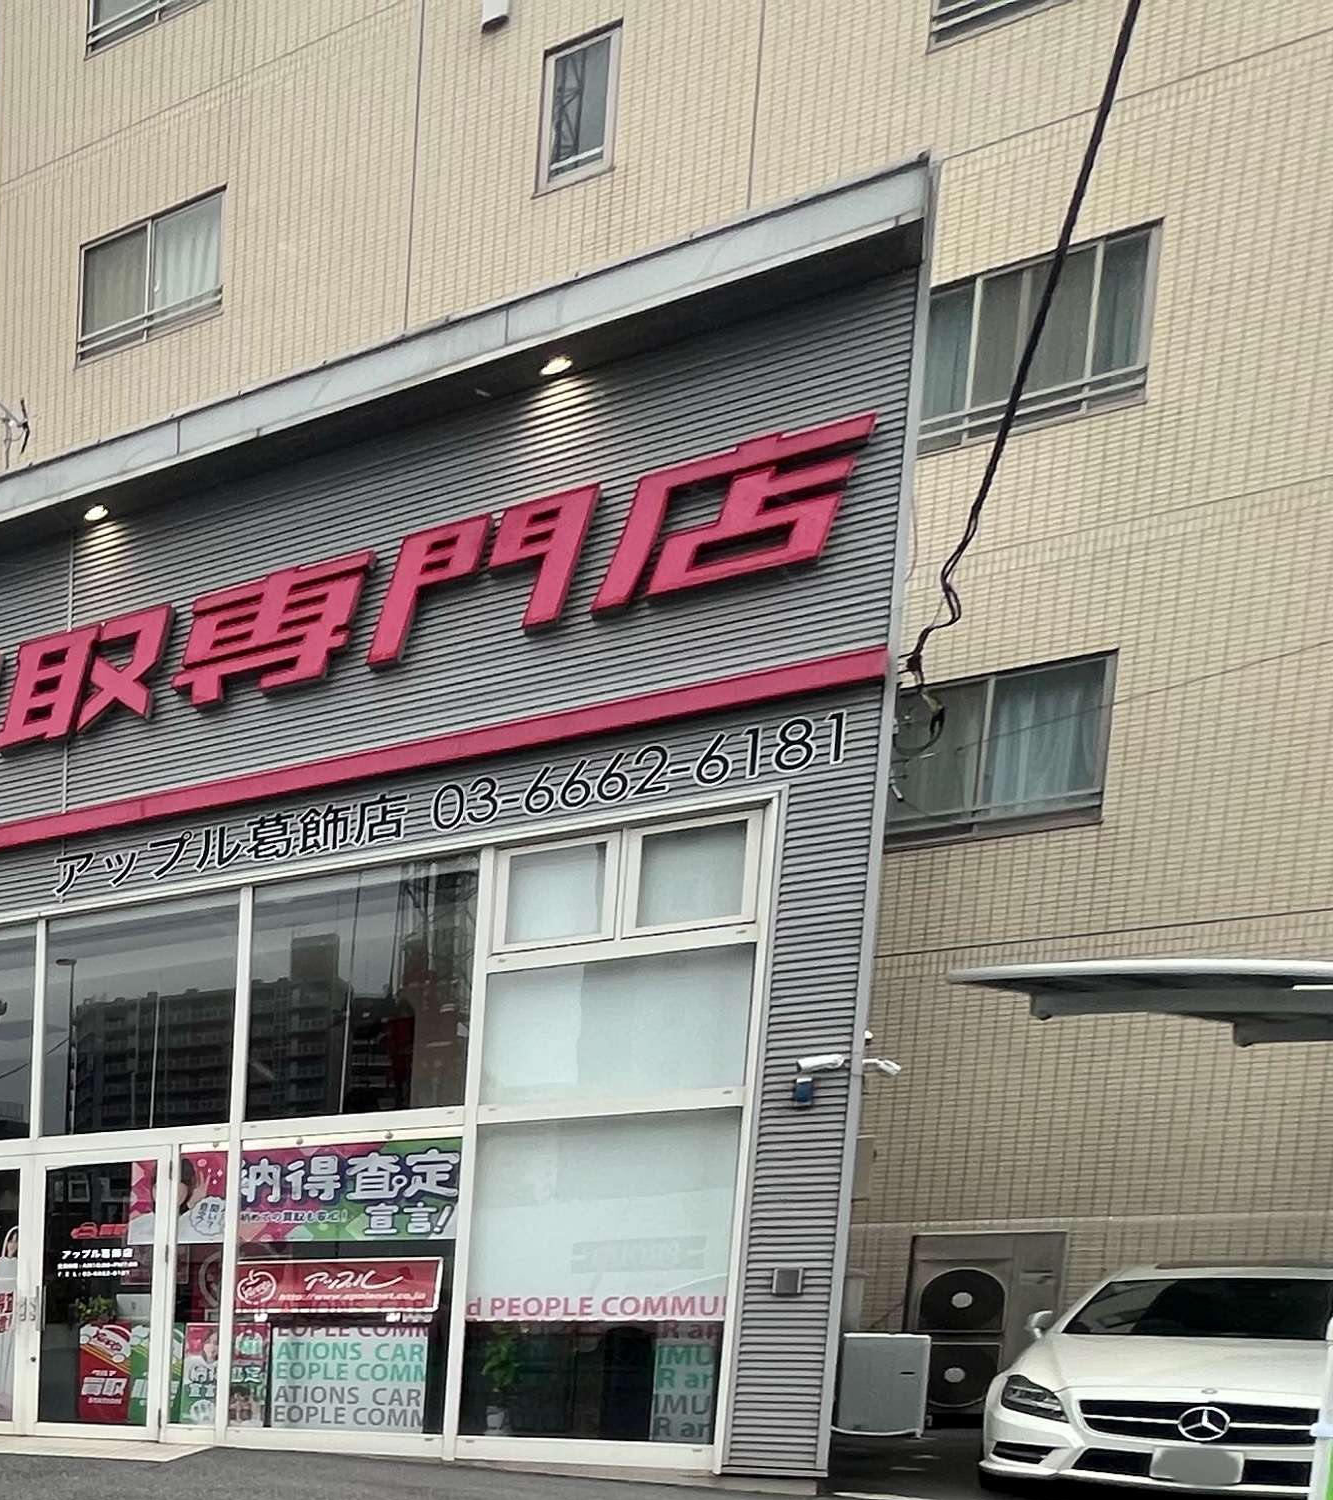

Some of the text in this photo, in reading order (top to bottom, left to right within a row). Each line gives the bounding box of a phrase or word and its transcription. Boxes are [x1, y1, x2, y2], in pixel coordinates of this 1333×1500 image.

[54, 711, 848, 896] アップル葛飾店 03-6662-6181
[241, 1148, 460, 1203] 納得査定
[489, 1296, 594, 1318] PEOPLE
